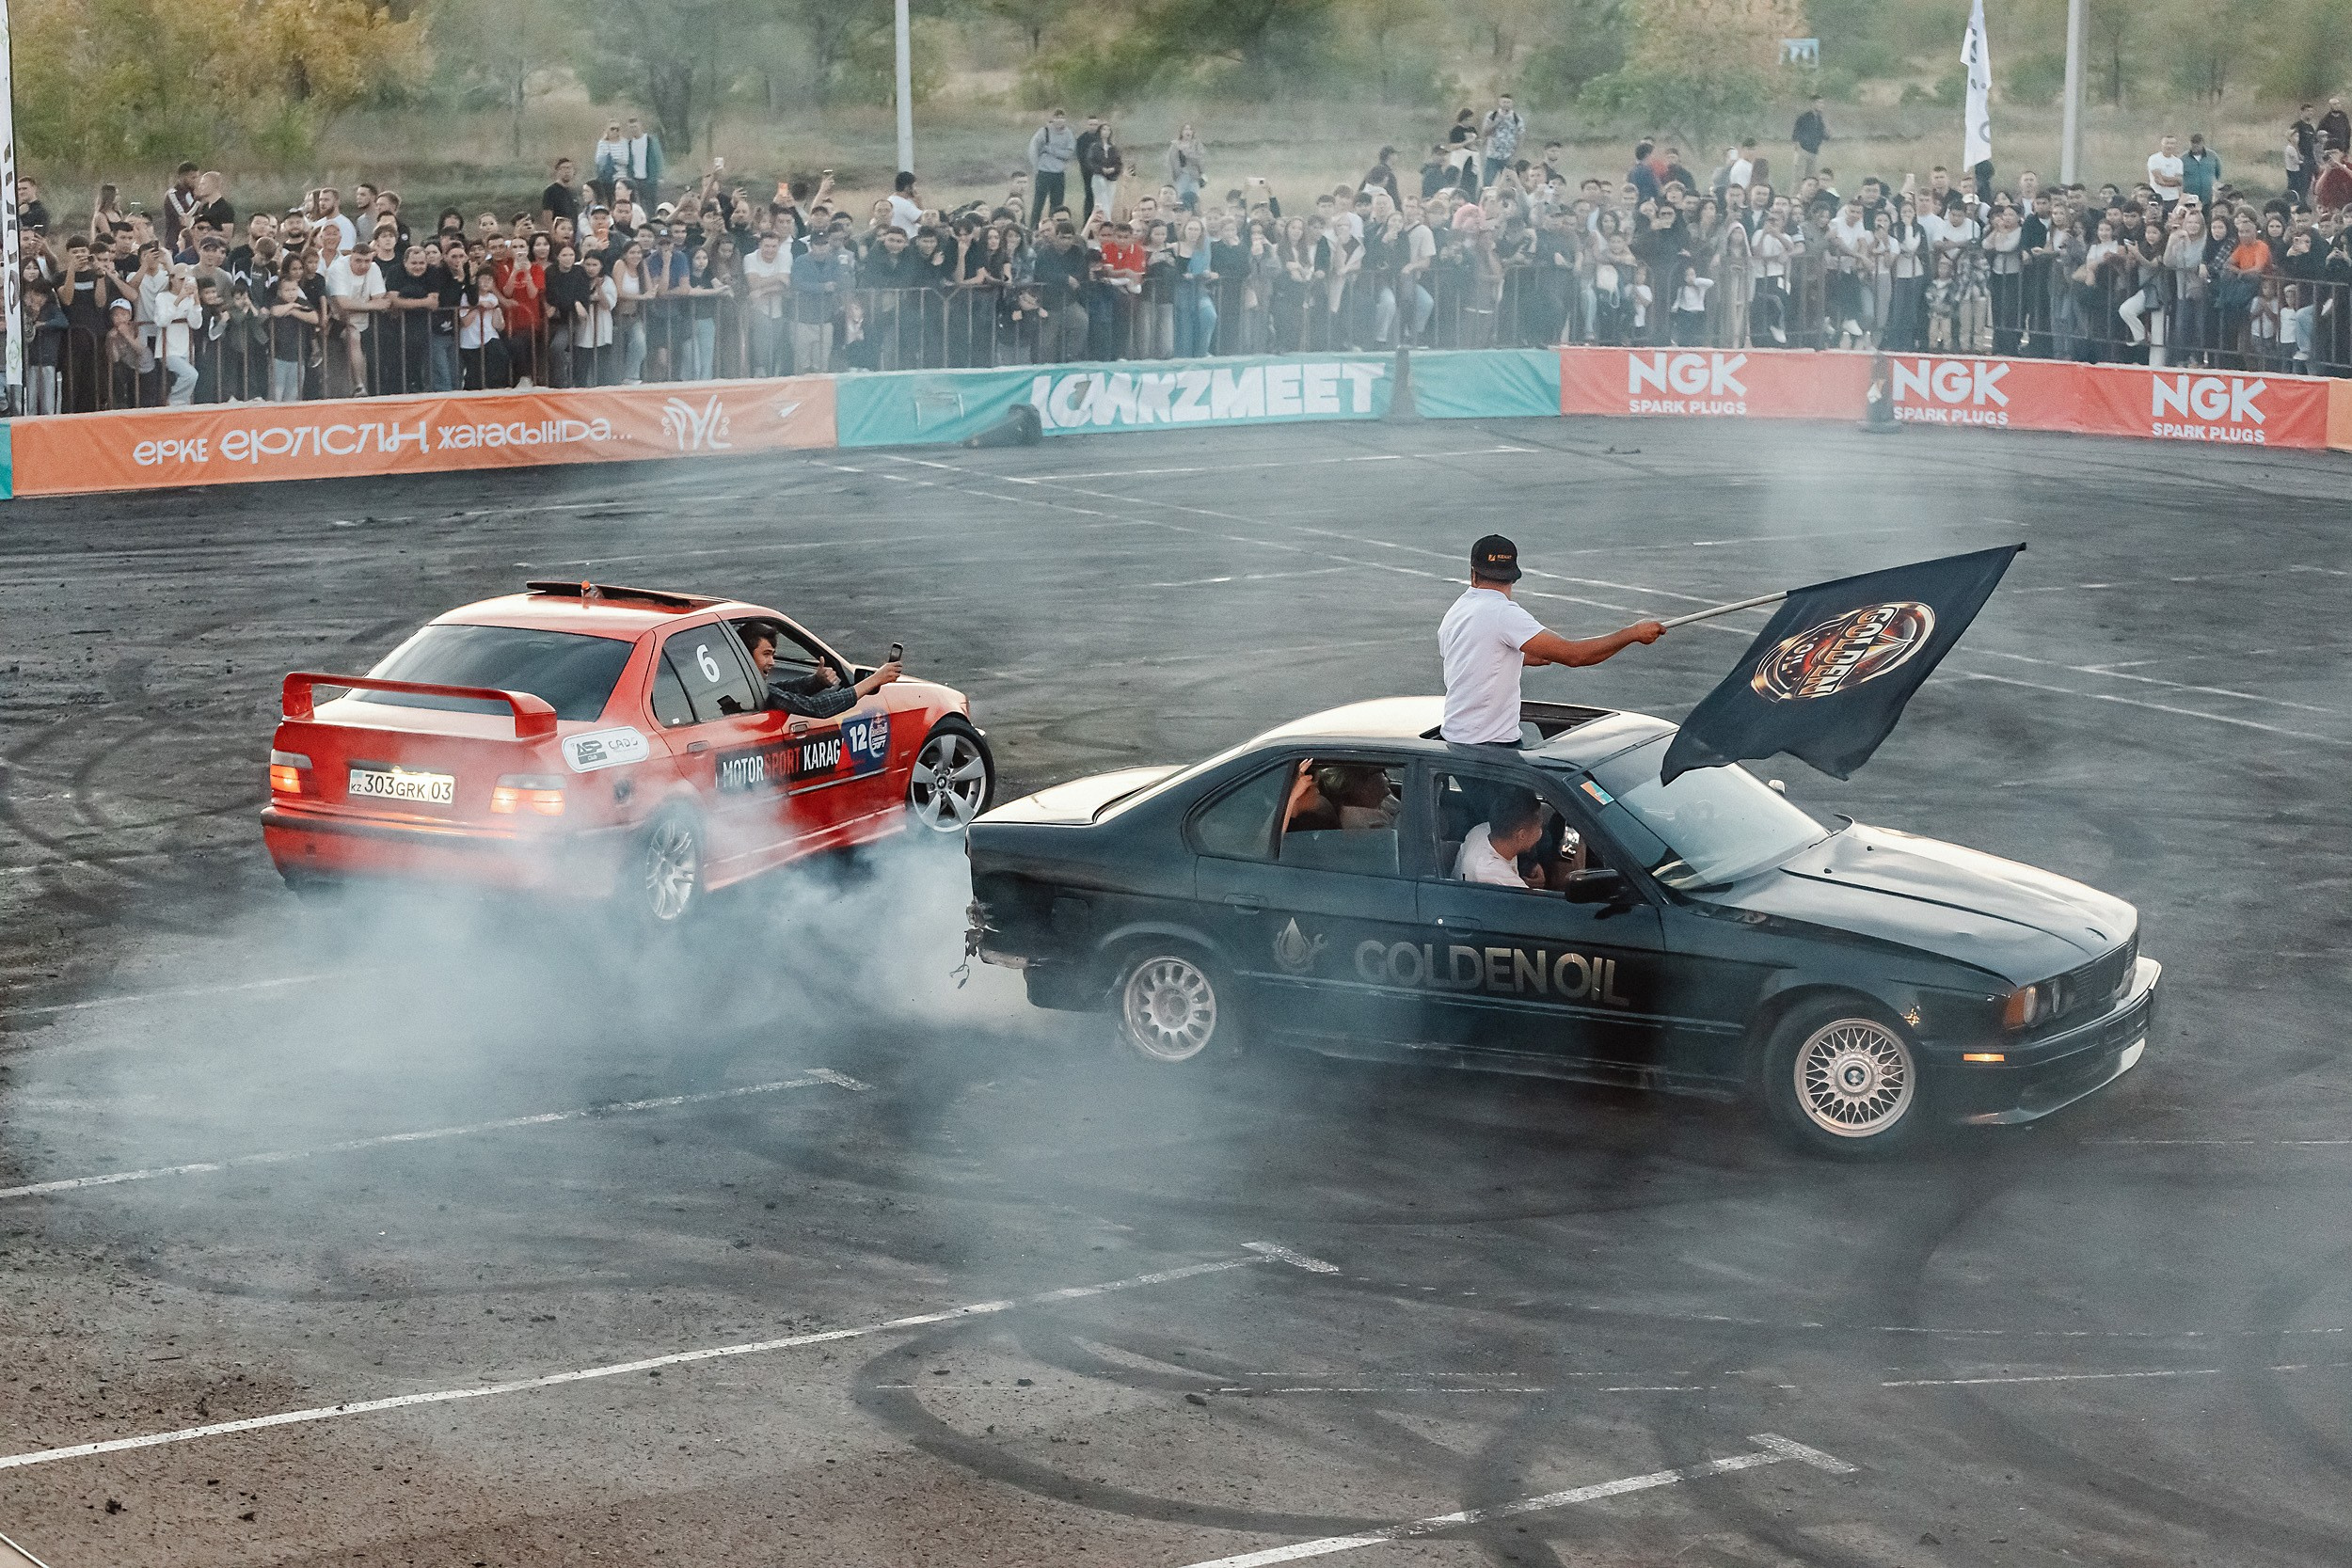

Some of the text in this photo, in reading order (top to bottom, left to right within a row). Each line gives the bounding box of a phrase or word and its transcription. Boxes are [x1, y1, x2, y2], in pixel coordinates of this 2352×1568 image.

[1629, 352, 1748, 397] NGK
[1892, 359, 2010, 407] NGK
[1629, 400, 1747, 415] SPARK PLUGS
[2152, 373, 2267, 425] NGK
[1893, 406, 2010, 425] SPARK PLUGS
[2152, 422, 2265, 443] SPARK PLUGS
[697, 644, 720, 683] 6
[1781, 642, 1814, 673] OIL
[1798, 607, 1895, 696] GOLDEN
[850, 723, 867, 752] 12
[803, 738, 844, 771] KARAG
[351, 784, 362, 792] KZ
[431, 782, 453, 800] 03
